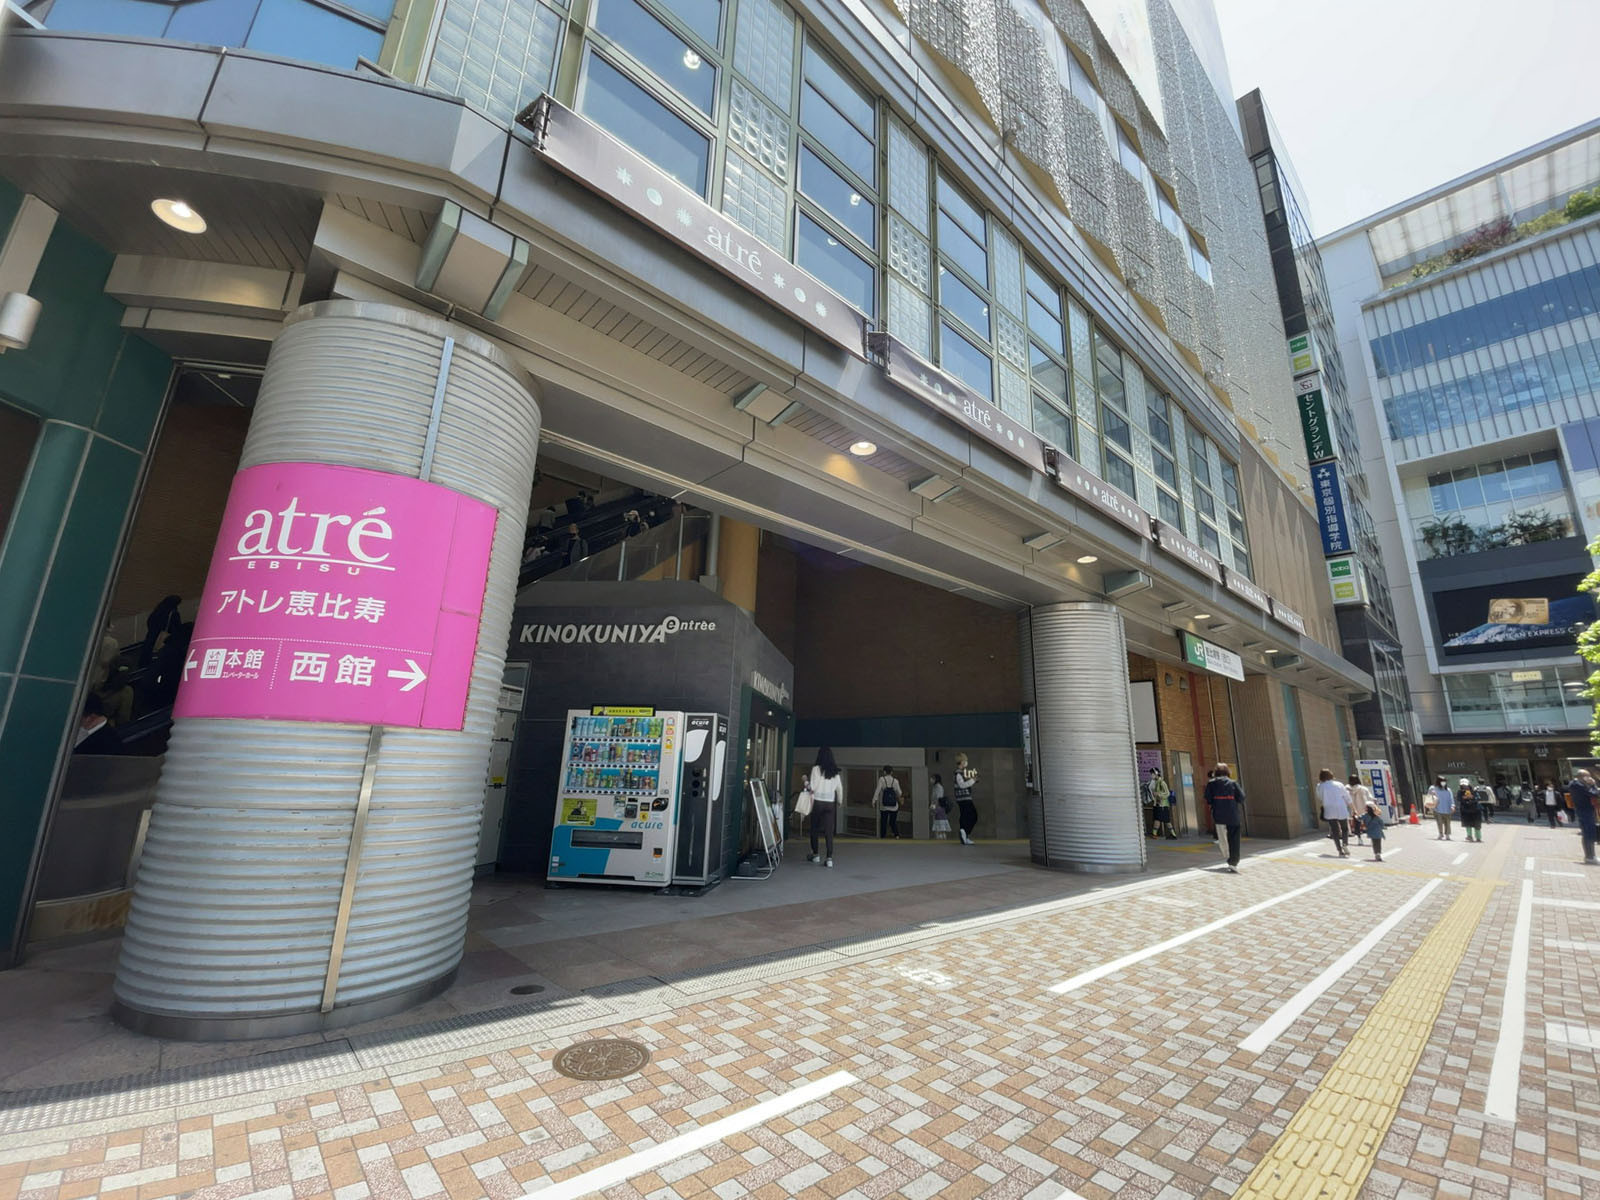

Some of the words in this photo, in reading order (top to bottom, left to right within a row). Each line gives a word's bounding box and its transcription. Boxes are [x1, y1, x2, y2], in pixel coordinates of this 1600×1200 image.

[706, 225, 762, 275] atré
[963, 399, 992, 427] atré
[237, 497, 392, 564] atré
[247, 560, 361, 576] EBISU
[216, 590, 387, 624] アトレ恵比寿
[519, 623, 666, 644] KINOKUNIYA
[1528, 626, 1566, 638] EXPRESS
[225, 648, 265, 670] 本館
[1193, 642, 1205, 658] JR
[290, 651, 376, 687] 西館
[630, 820, 664, 830] acure
